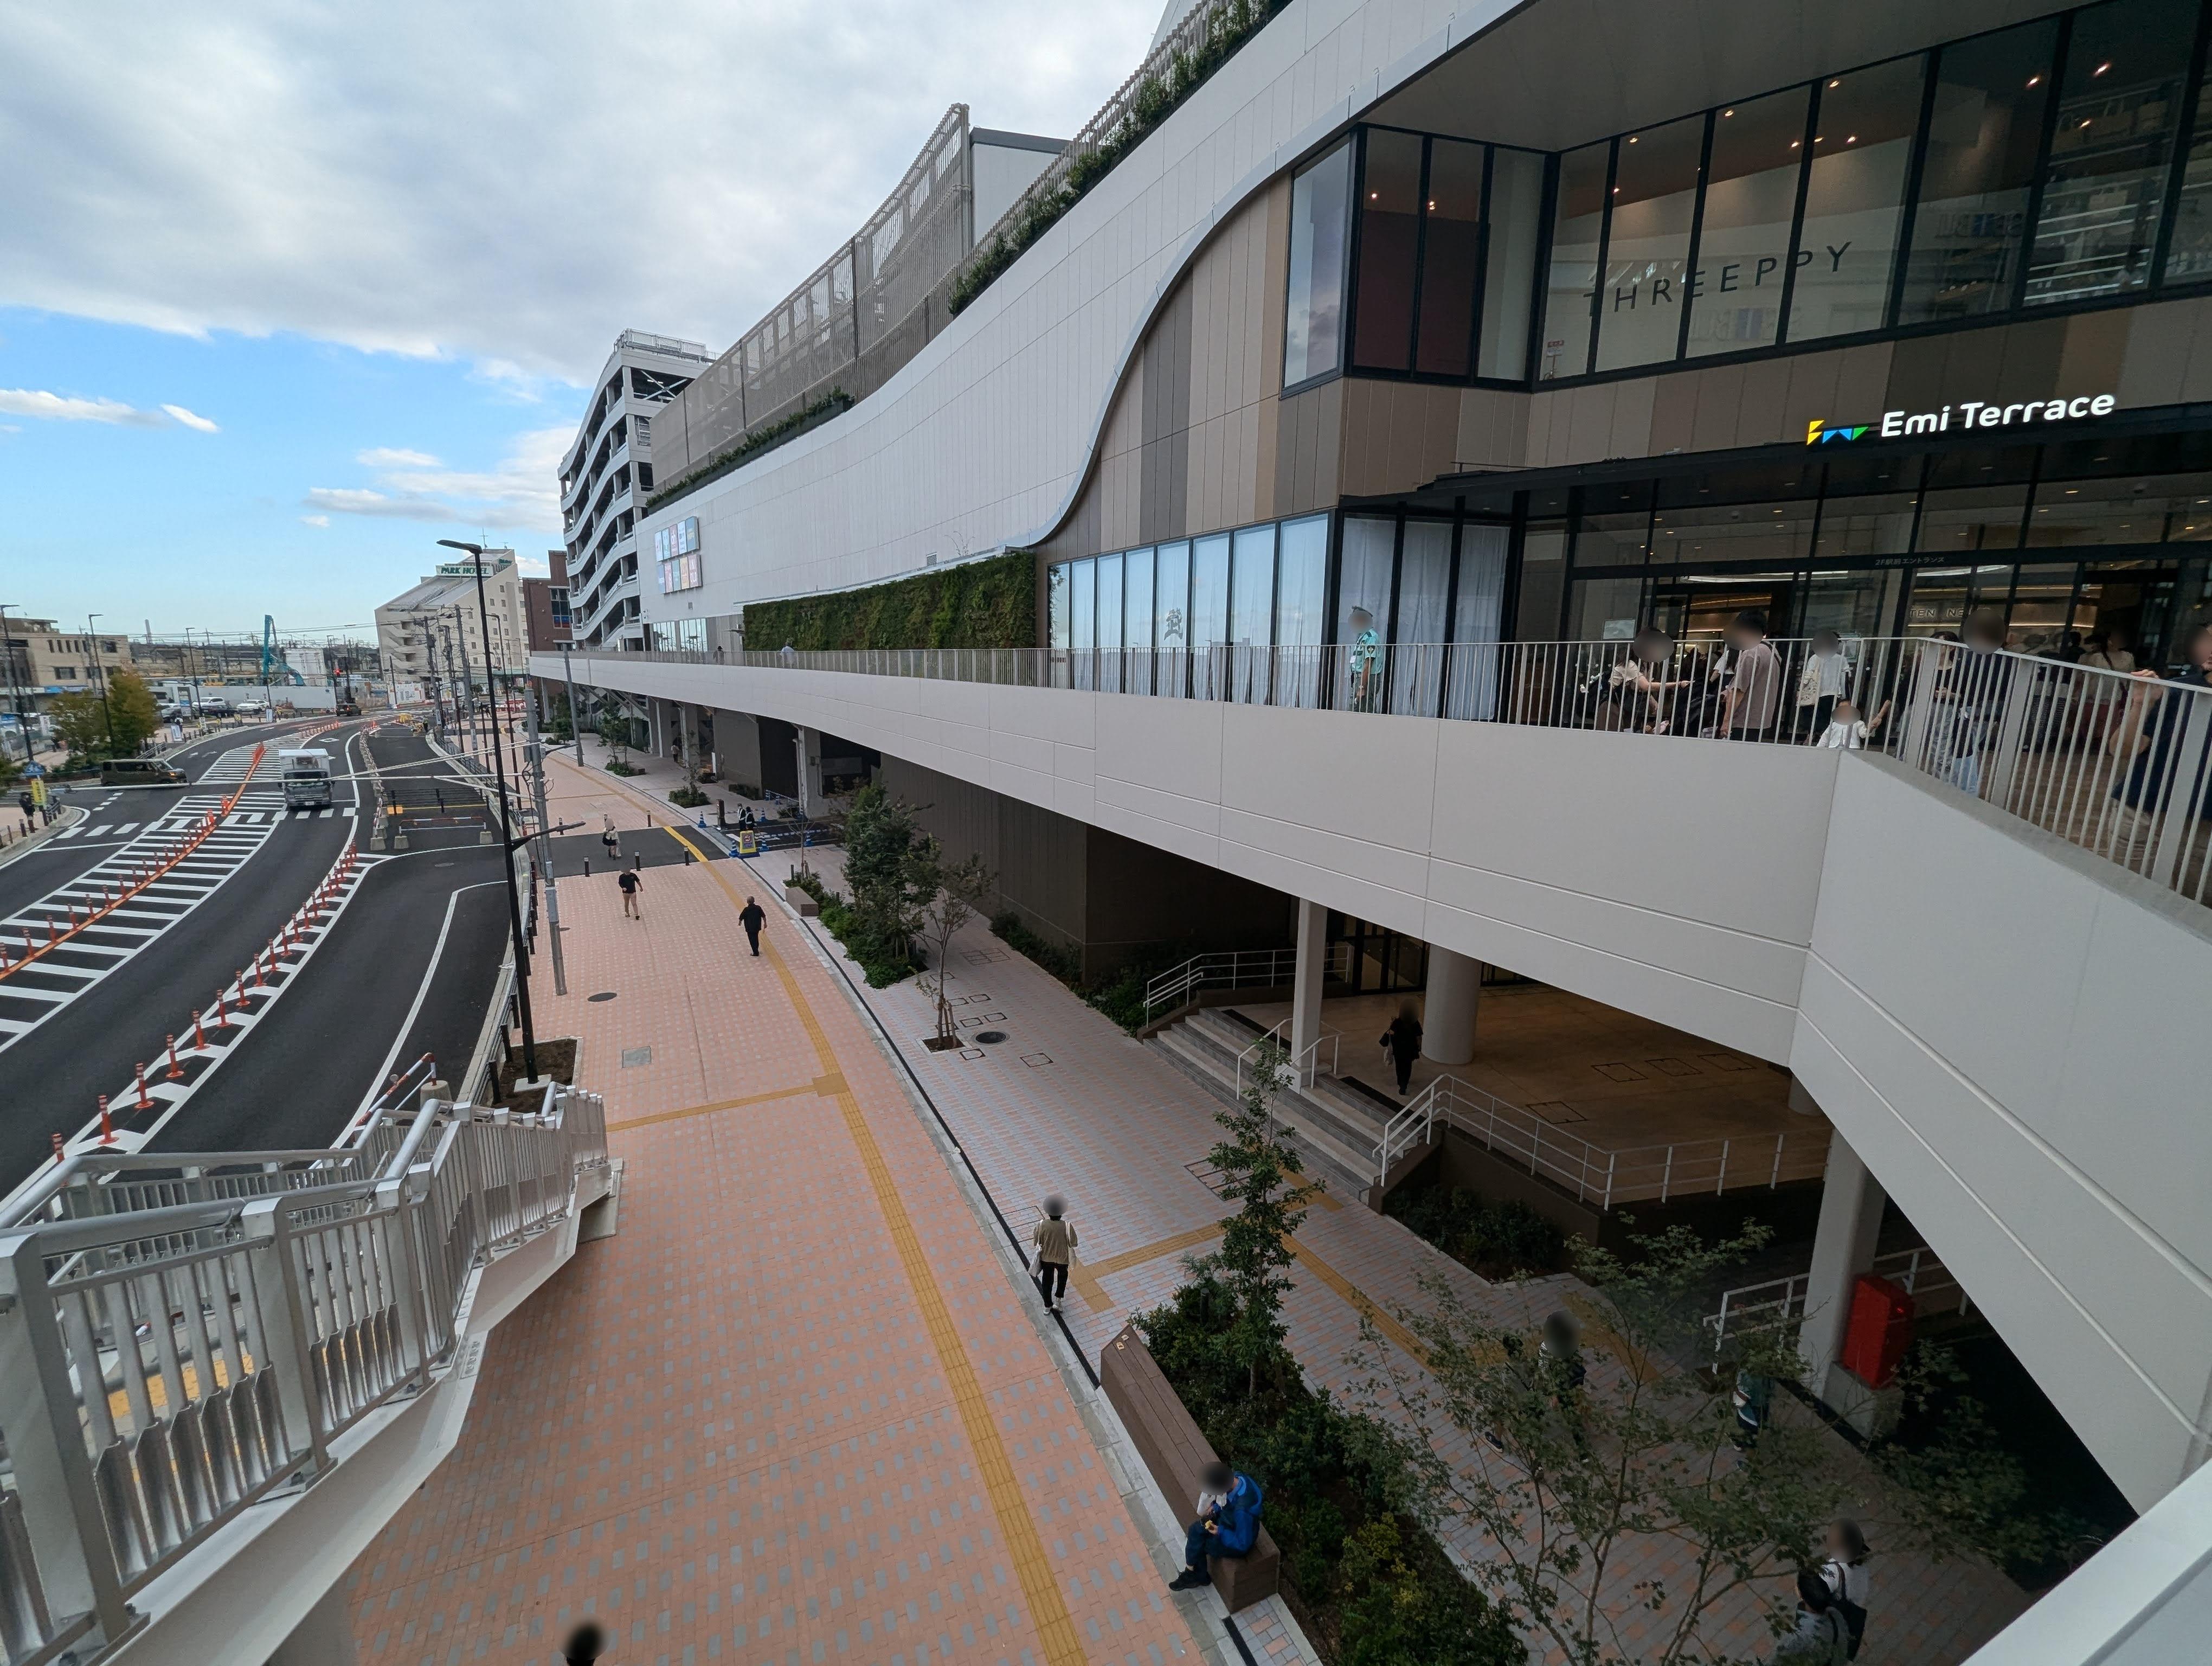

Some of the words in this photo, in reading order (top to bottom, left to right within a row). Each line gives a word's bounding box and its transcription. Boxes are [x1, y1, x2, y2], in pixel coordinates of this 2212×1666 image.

[1583, 241, 1852, 317] THREEPPY
[1881, 405, 1951, 437] Emi
[1959, 394, 2115, 429] Terrace
